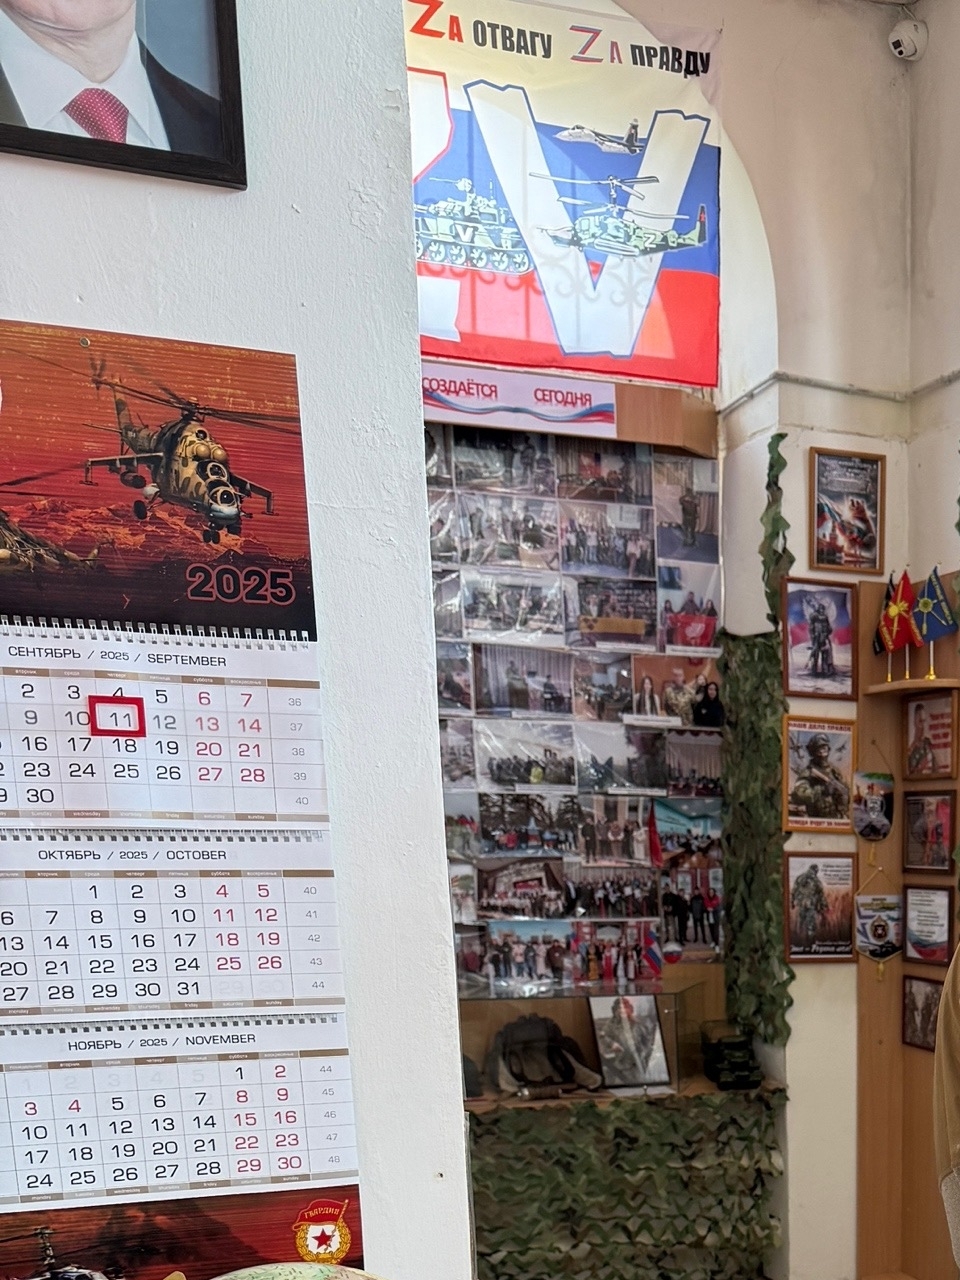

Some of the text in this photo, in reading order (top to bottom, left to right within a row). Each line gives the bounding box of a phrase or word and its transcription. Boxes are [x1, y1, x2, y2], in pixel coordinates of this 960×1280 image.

[472, 20, 552, 58] ОТВАГУ
[630, 44, 711, 78] ПРАВДУ
[422, 377, 592, 406] СОЗДАЁТСЯ СЕГОДНЯ
[186, 564, 297, 606] 2025
[8, 646, 227, 667] СЕНТЯБРЬ 2025 SEPTEMBER
[22, 684, 252, 707] 2 3 5 6 7
[25, 710, 261, 732] 9 10 11 12 13 14
[22, 737, 260, 757] 16 17 18 19 20 21
[24, 763, 265, 782] 23 24 25 26 27 28
[38, 850, 227, 861] ОКТЯБРЬ 2025 OCTOBER
[88, 885, 269, 899] 1 2 3 4 5
[1, 909, 277, 925] 6 7 8 9 10 11 12
[44, 933, 279, 949] 14 15 16 17 18 19
[0, 956, 281, 976] 20 21 22 23 24 25 26
[3, 982, 199, 1001] 27 28 29 30 31
[68, 1033, 256, 1051] НОЯБРЬ 2025 NOVEMBER
[304, 1207, 340, 1219] ГВАРДИЯ
